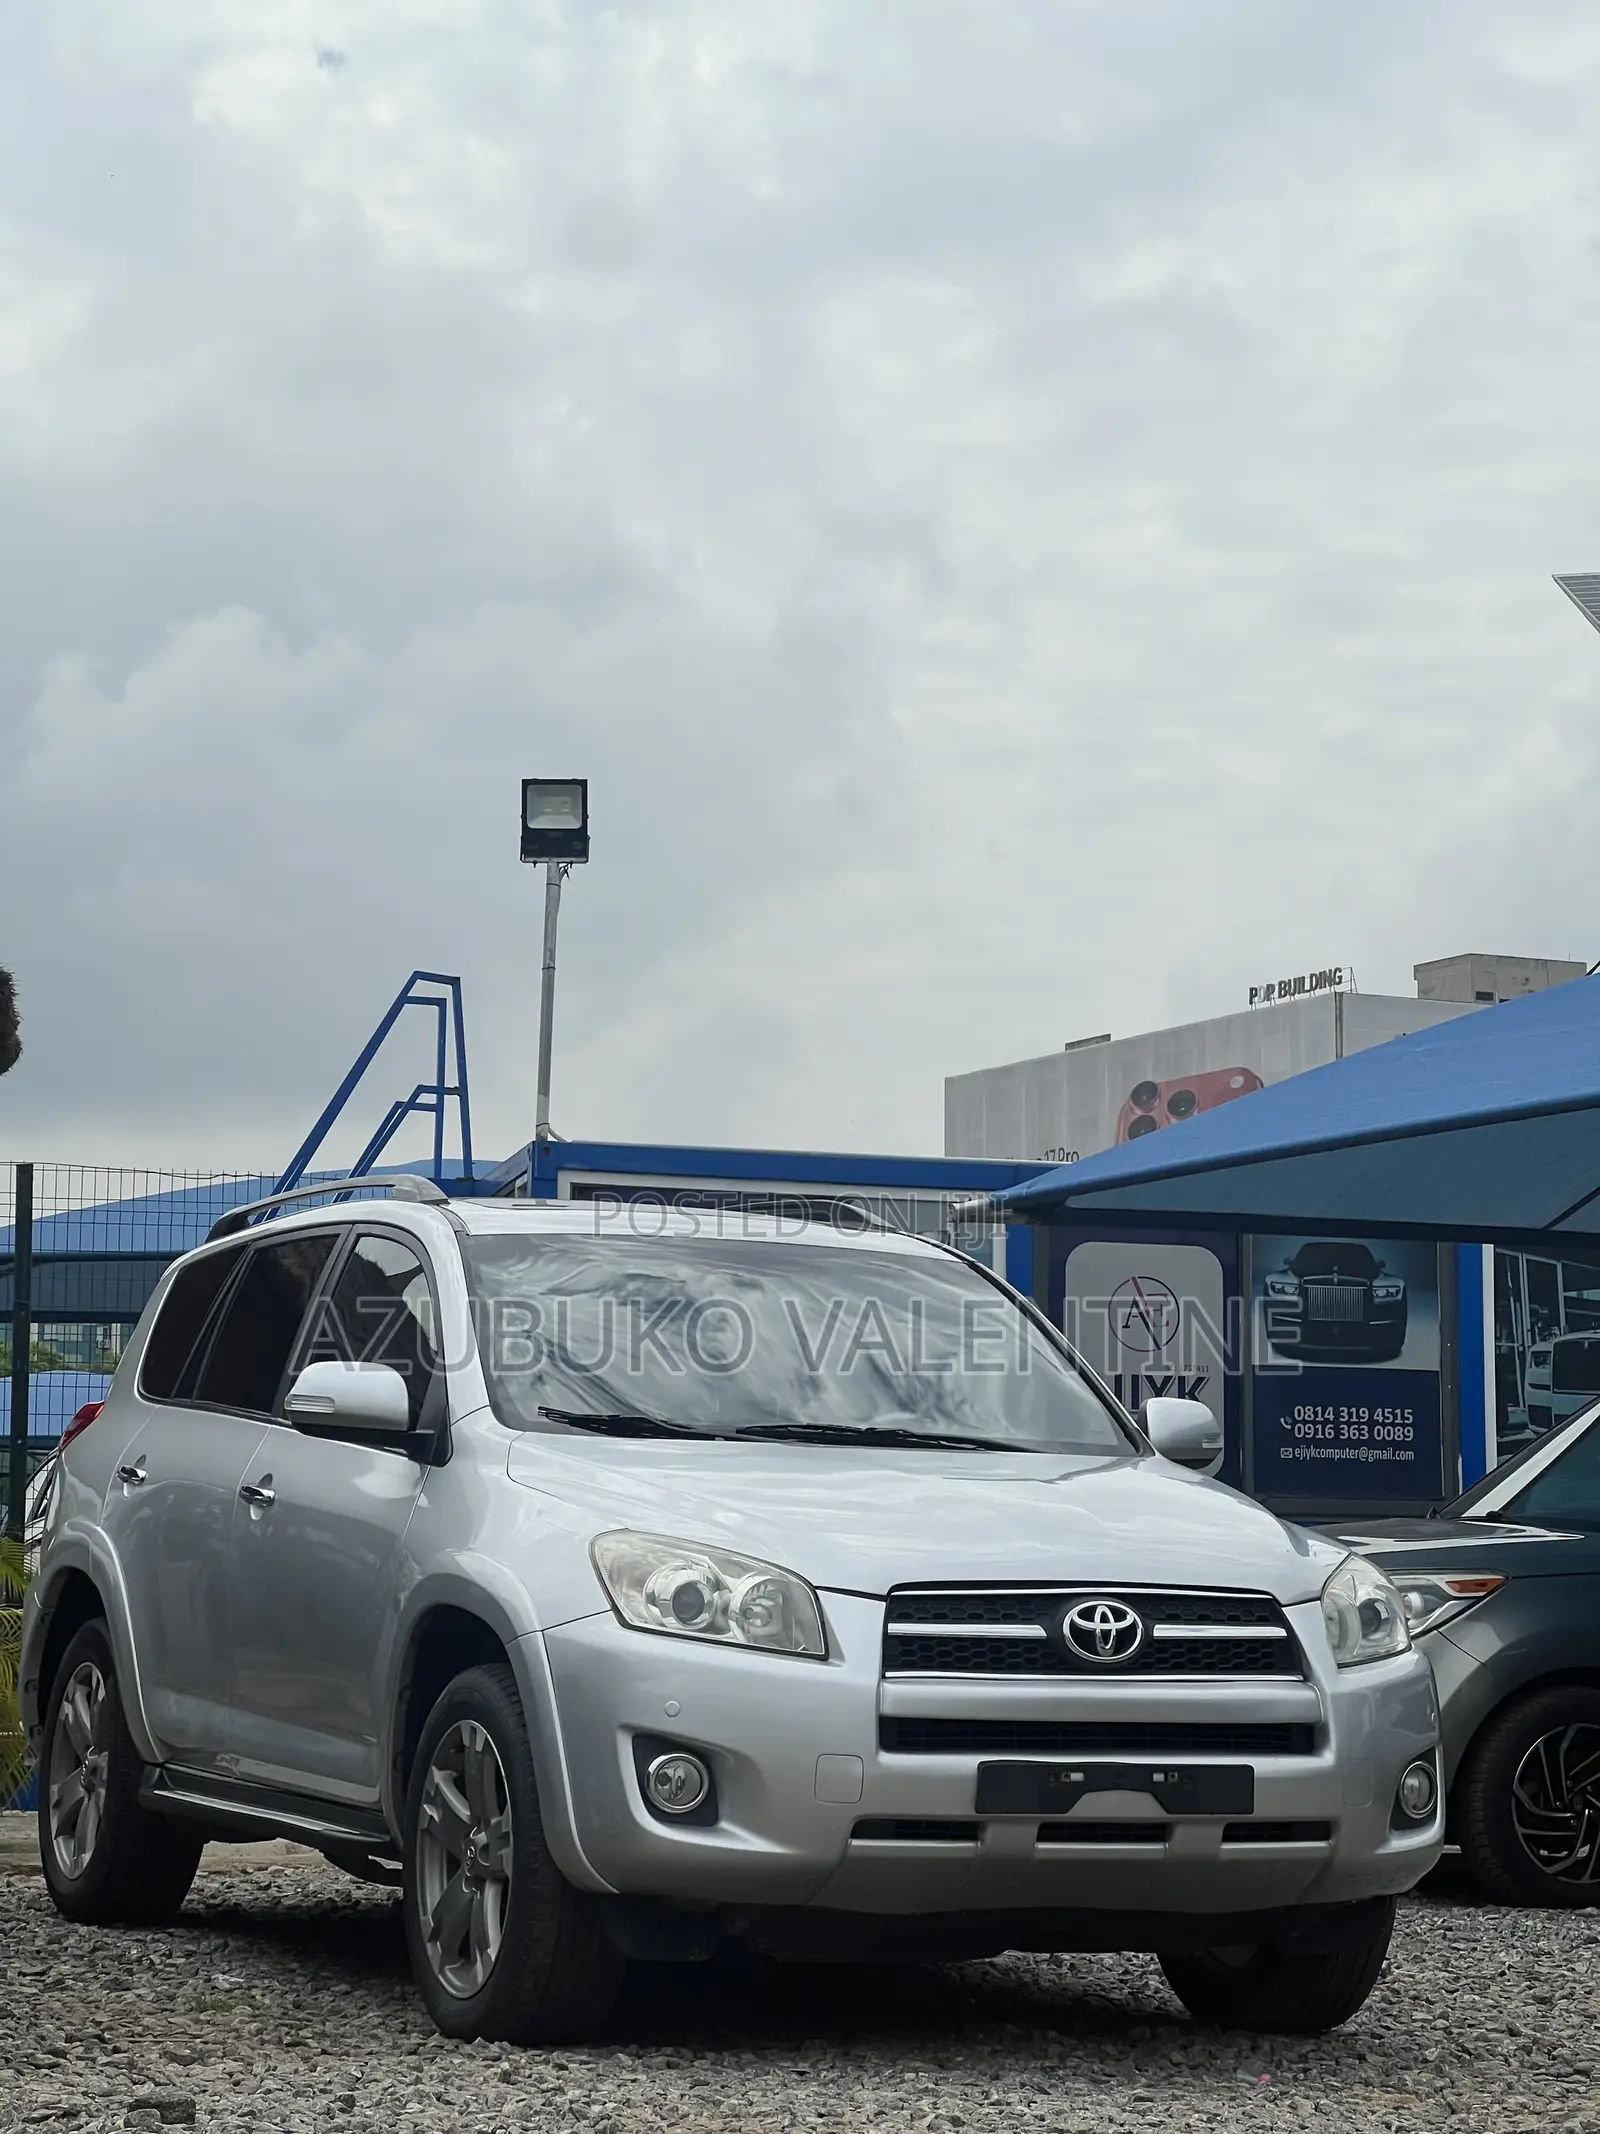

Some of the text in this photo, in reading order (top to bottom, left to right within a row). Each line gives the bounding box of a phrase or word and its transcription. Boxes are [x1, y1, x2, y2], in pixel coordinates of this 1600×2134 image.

[1278, 967, 1343, 999] BUILDING
[1294, 1405, 1413, 1424] 0814 319 4515
[1294, 1423, 1414, 1441] 0916 363 0089
[1294, 1444, 1415, 1462] ejiykcomputer@gmail.com
